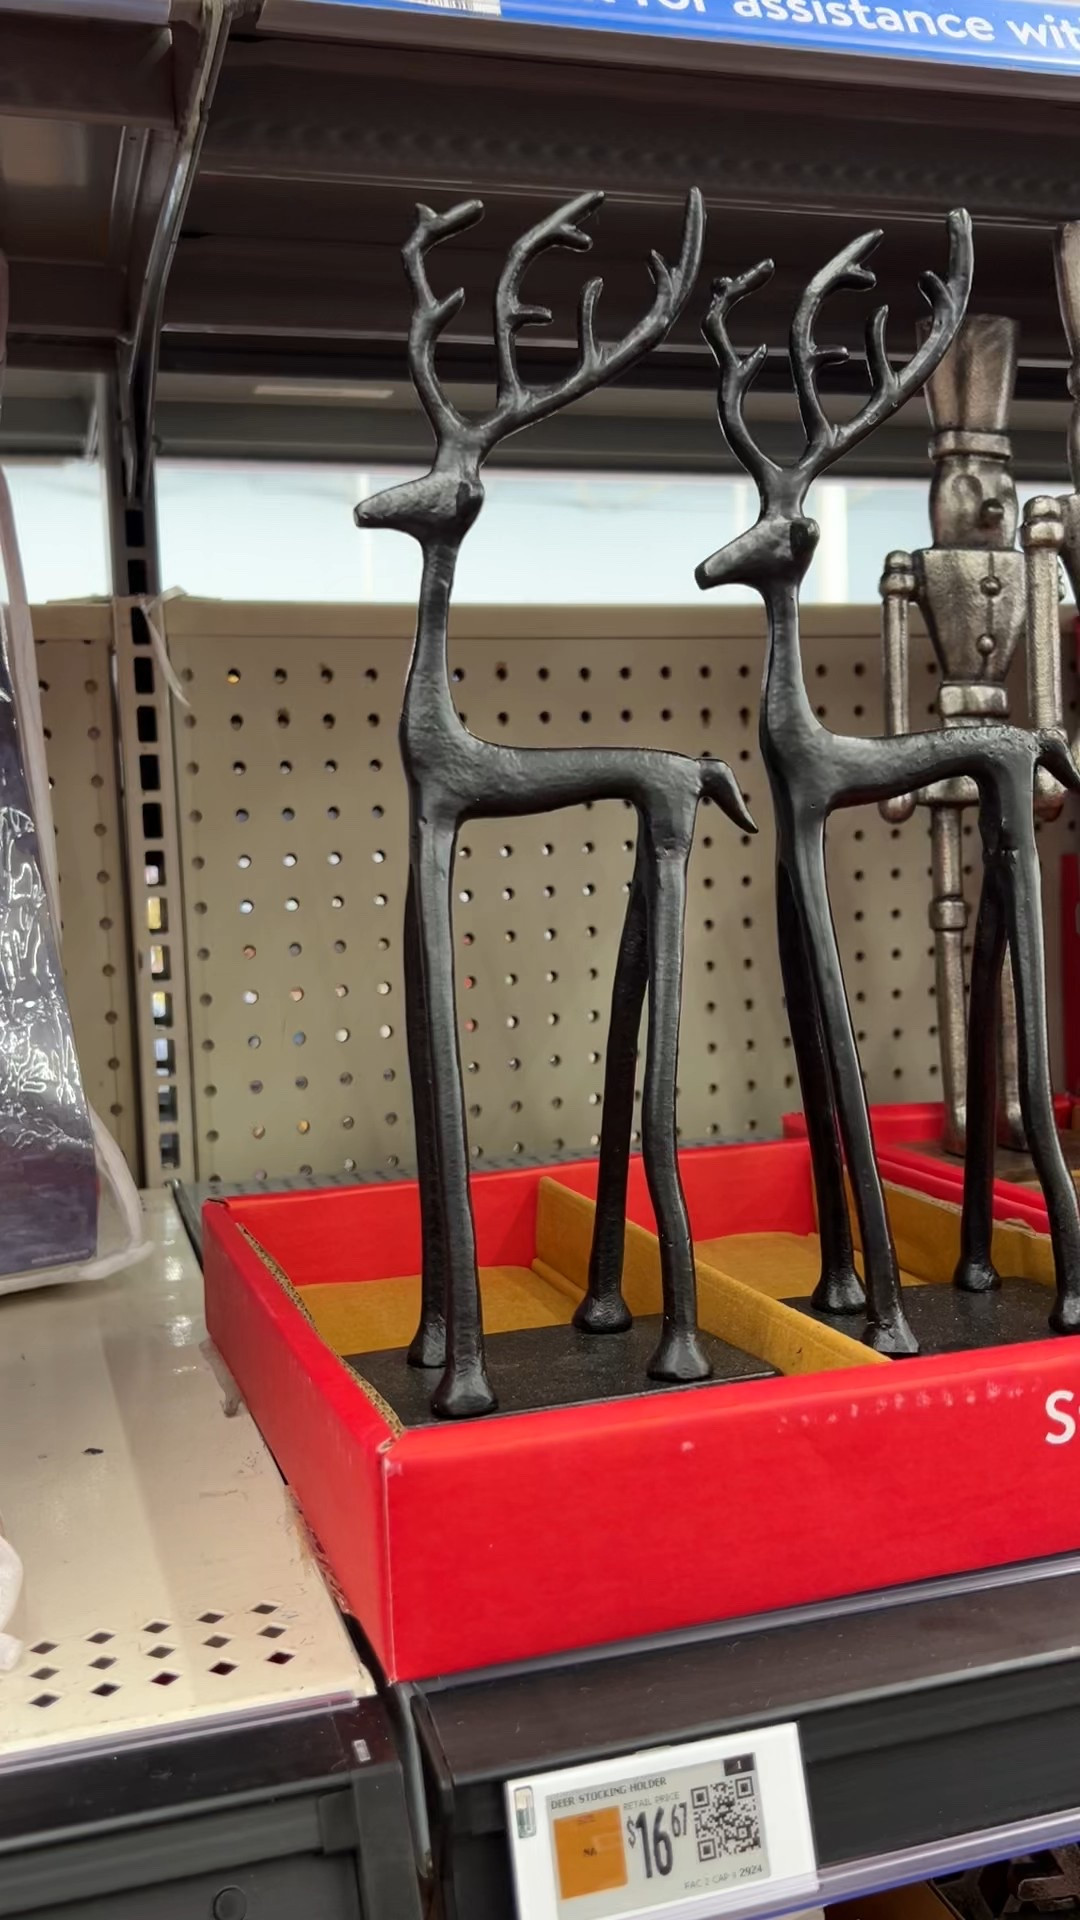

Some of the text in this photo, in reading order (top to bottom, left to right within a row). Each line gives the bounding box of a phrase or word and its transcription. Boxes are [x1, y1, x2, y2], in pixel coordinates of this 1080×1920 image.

[733, 0, 1080, 51] assistance wit
[1045, 1389, 1080, 1445] S
[551, 1777, 667, 1809] DEER STOCKING HOLDER
